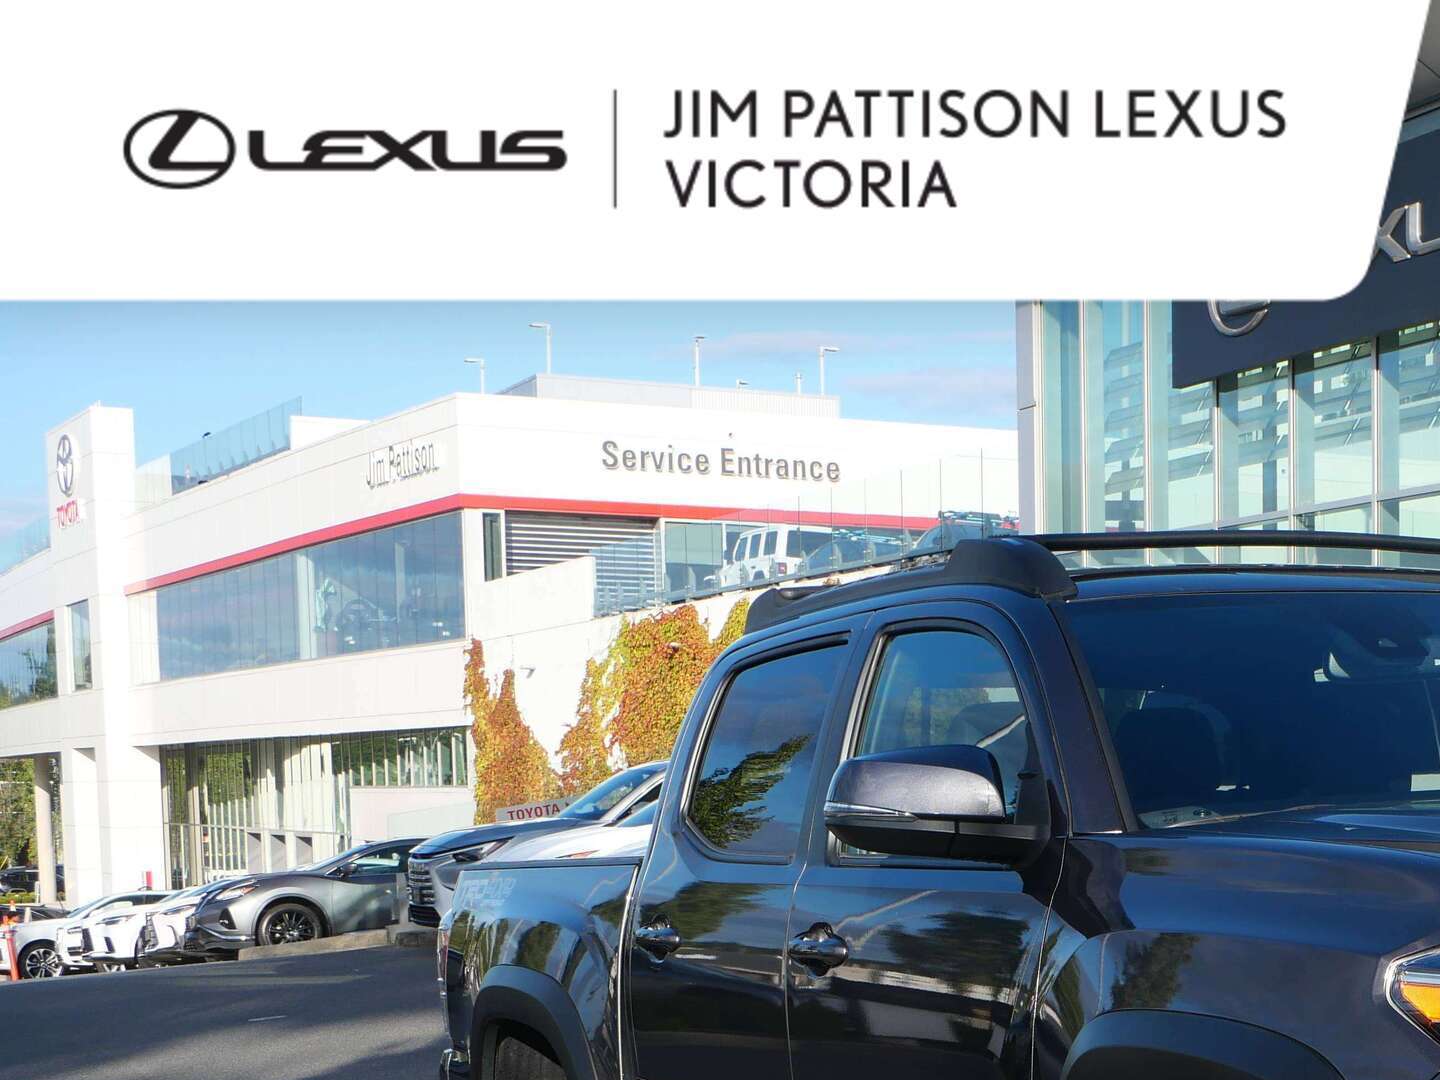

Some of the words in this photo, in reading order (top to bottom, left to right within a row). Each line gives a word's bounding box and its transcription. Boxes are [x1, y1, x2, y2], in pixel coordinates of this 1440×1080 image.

[366, 450, 385, 487] Jim
[388, 440, 435, 481] Pattison
[601, 440, 710, 475] Service
[720, 447, 841, 482] Entrance
[507, 803, 561, 821] TOYOTA
